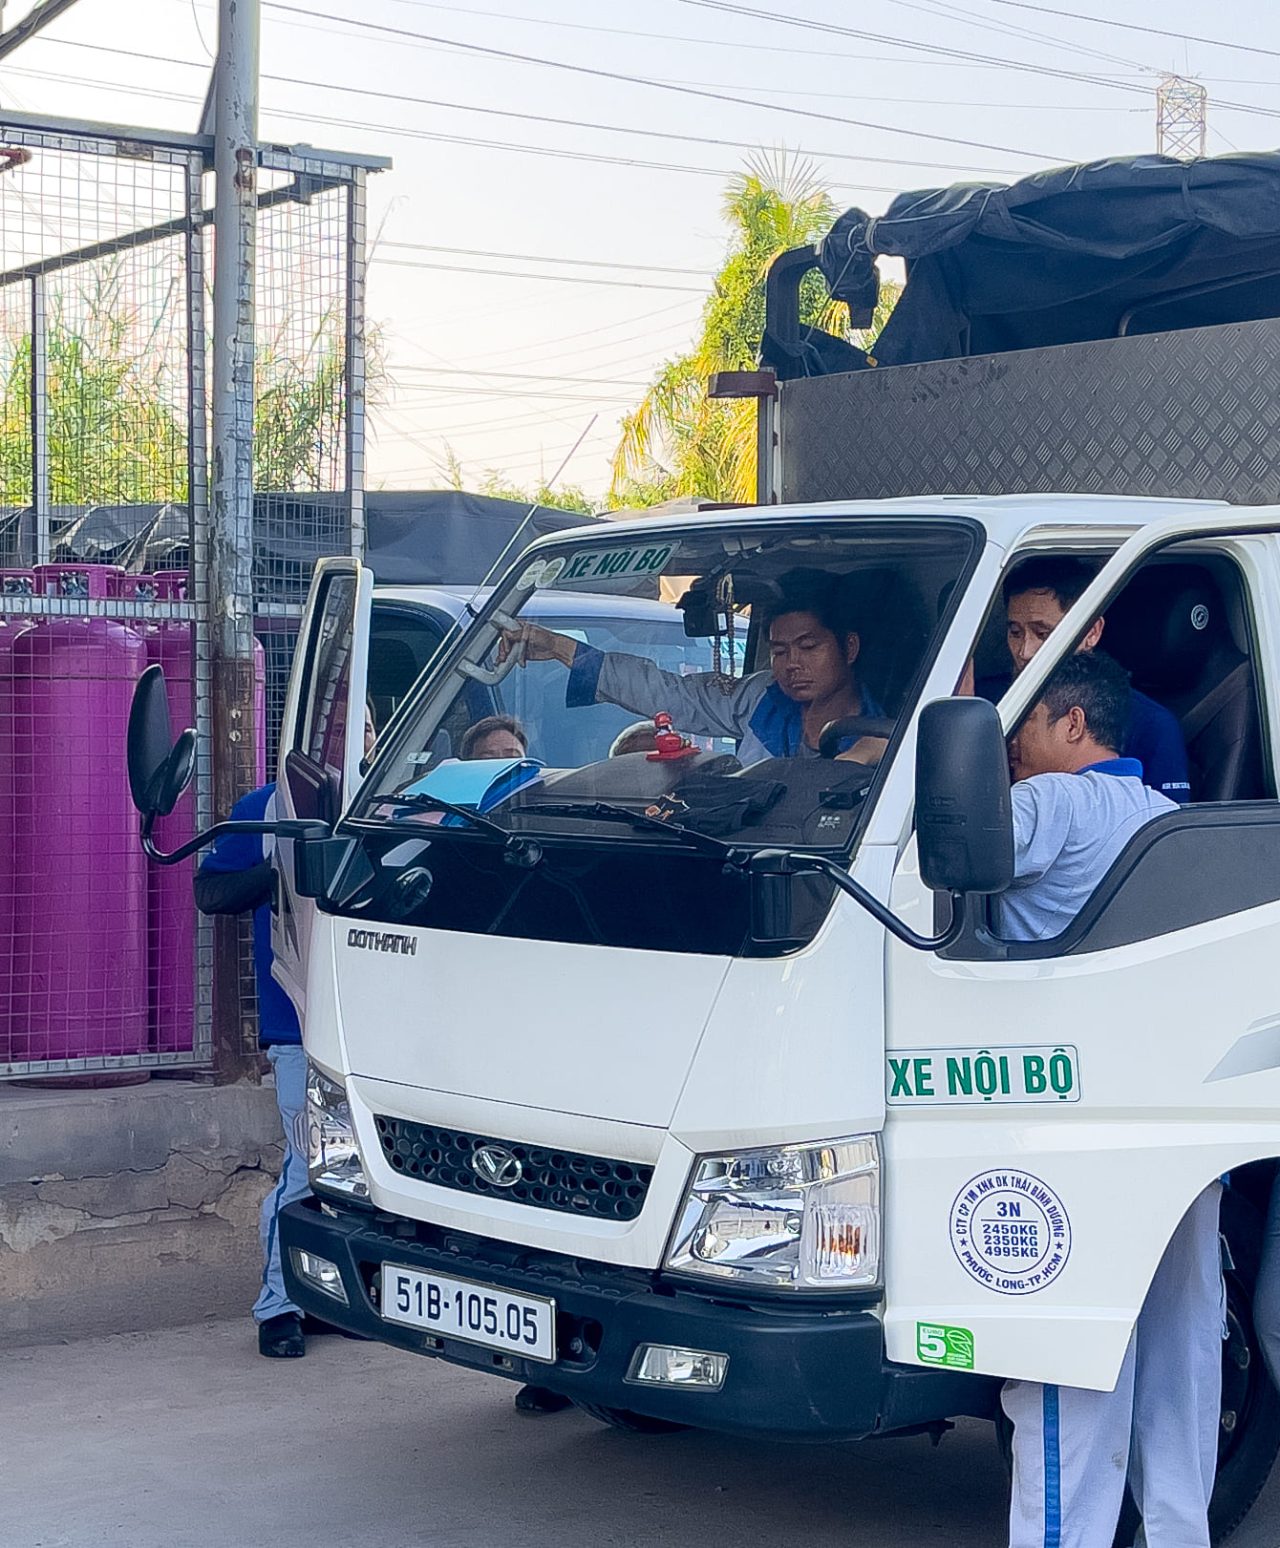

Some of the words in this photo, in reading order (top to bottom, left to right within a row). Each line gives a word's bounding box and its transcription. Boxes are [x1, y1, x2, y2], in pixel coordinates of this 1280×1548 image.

[562, 555, 598, 579] XE
[592, 548, 638, 577] NỘI
[635, 543, 672, 573] BỘ
[888, 1058, 935, 1097] XE
[946, 1050, 1010, 1101] NỘI
[1023, 1048, 1073, 1099] BỘ
[975, 1178, 995, 1195] XNK
[1011, 1176, 1032, 1192] THÁI
[964, 1190, 979, 1204] TM
[1030, 1186, 1053, 1207] BÌNH
[958, 1203, 971, 1217] CP
[996, 1201, 1021, 1217] 3N
[955, 1218, 967, 1235] CTT
[982, 1224, 1038, 1235] 2450KG
[1046, 1205, 1065, 1238] DƯƠNG
[984, 1235, 1038, 1246] 2350KG
[984, 1246, 1039, 1257] 4995KG
[962, 1250, 994, 1283] PHƯỚC
[996, 1253, 1063, 1290] LONG-TP.HCM
[397, 1276, 537, 1345] 51B-105.05
[920, 1326, 946, 1358] 5
